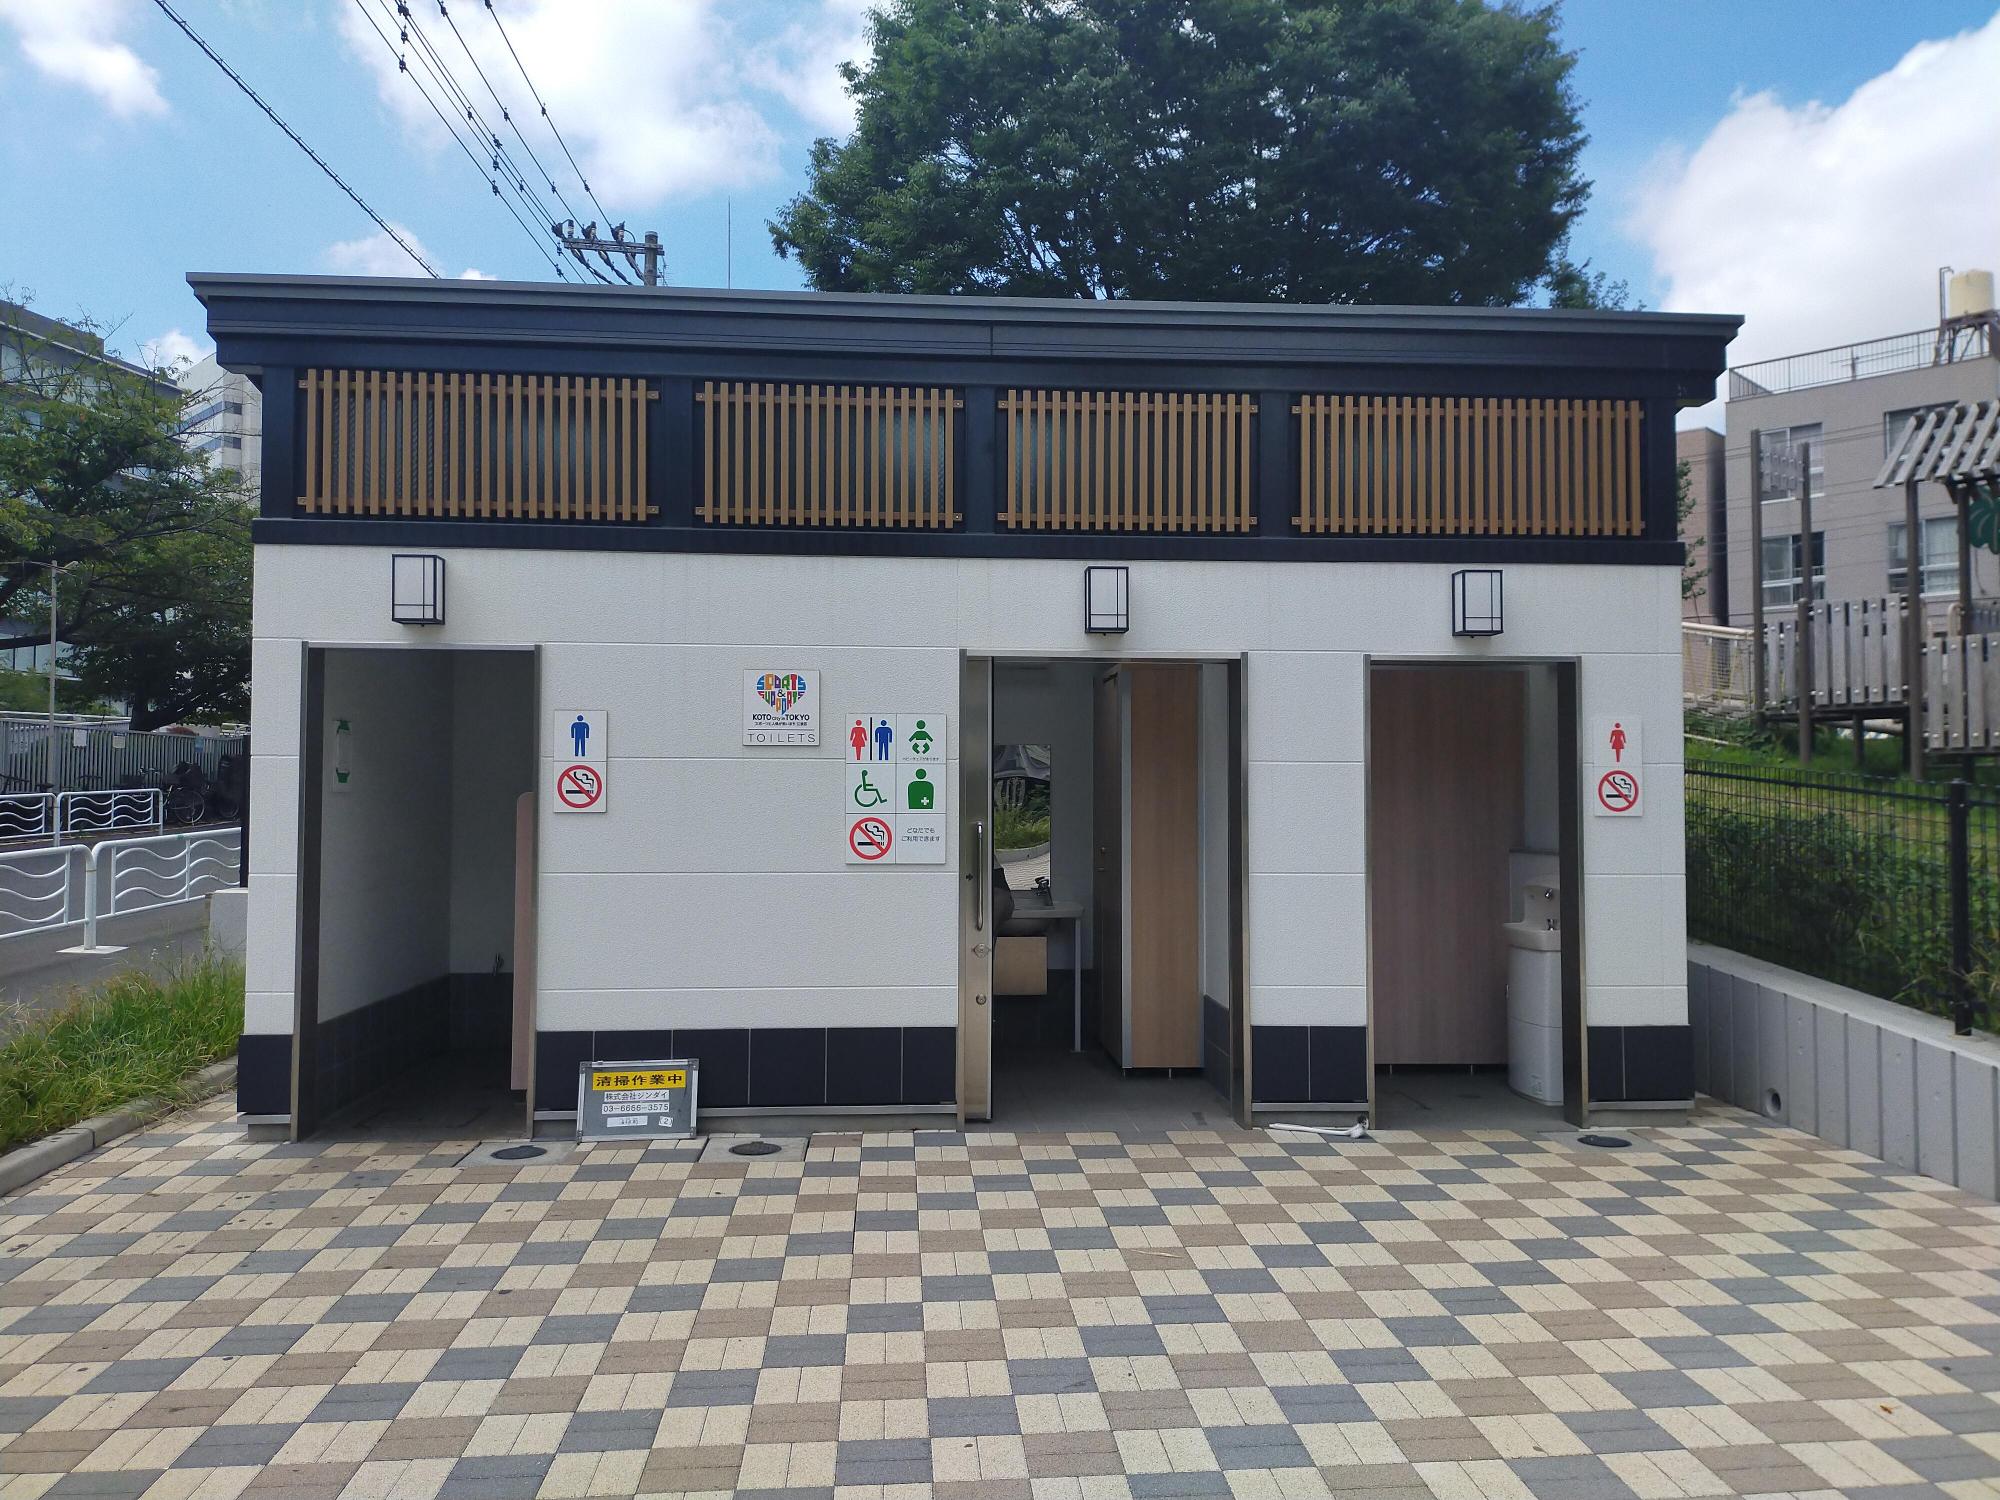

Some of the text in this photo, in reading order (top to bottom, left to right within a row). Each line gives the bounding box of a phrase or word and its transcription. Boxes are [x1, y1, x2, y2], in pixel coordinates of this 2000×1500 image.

[757, 674, 806, 690] SPORTS
[777, 689, 786, 698] &
[747, 734, 816, 742] TOILETS
[597, 1074, 682, 1086] 清掃作業中
